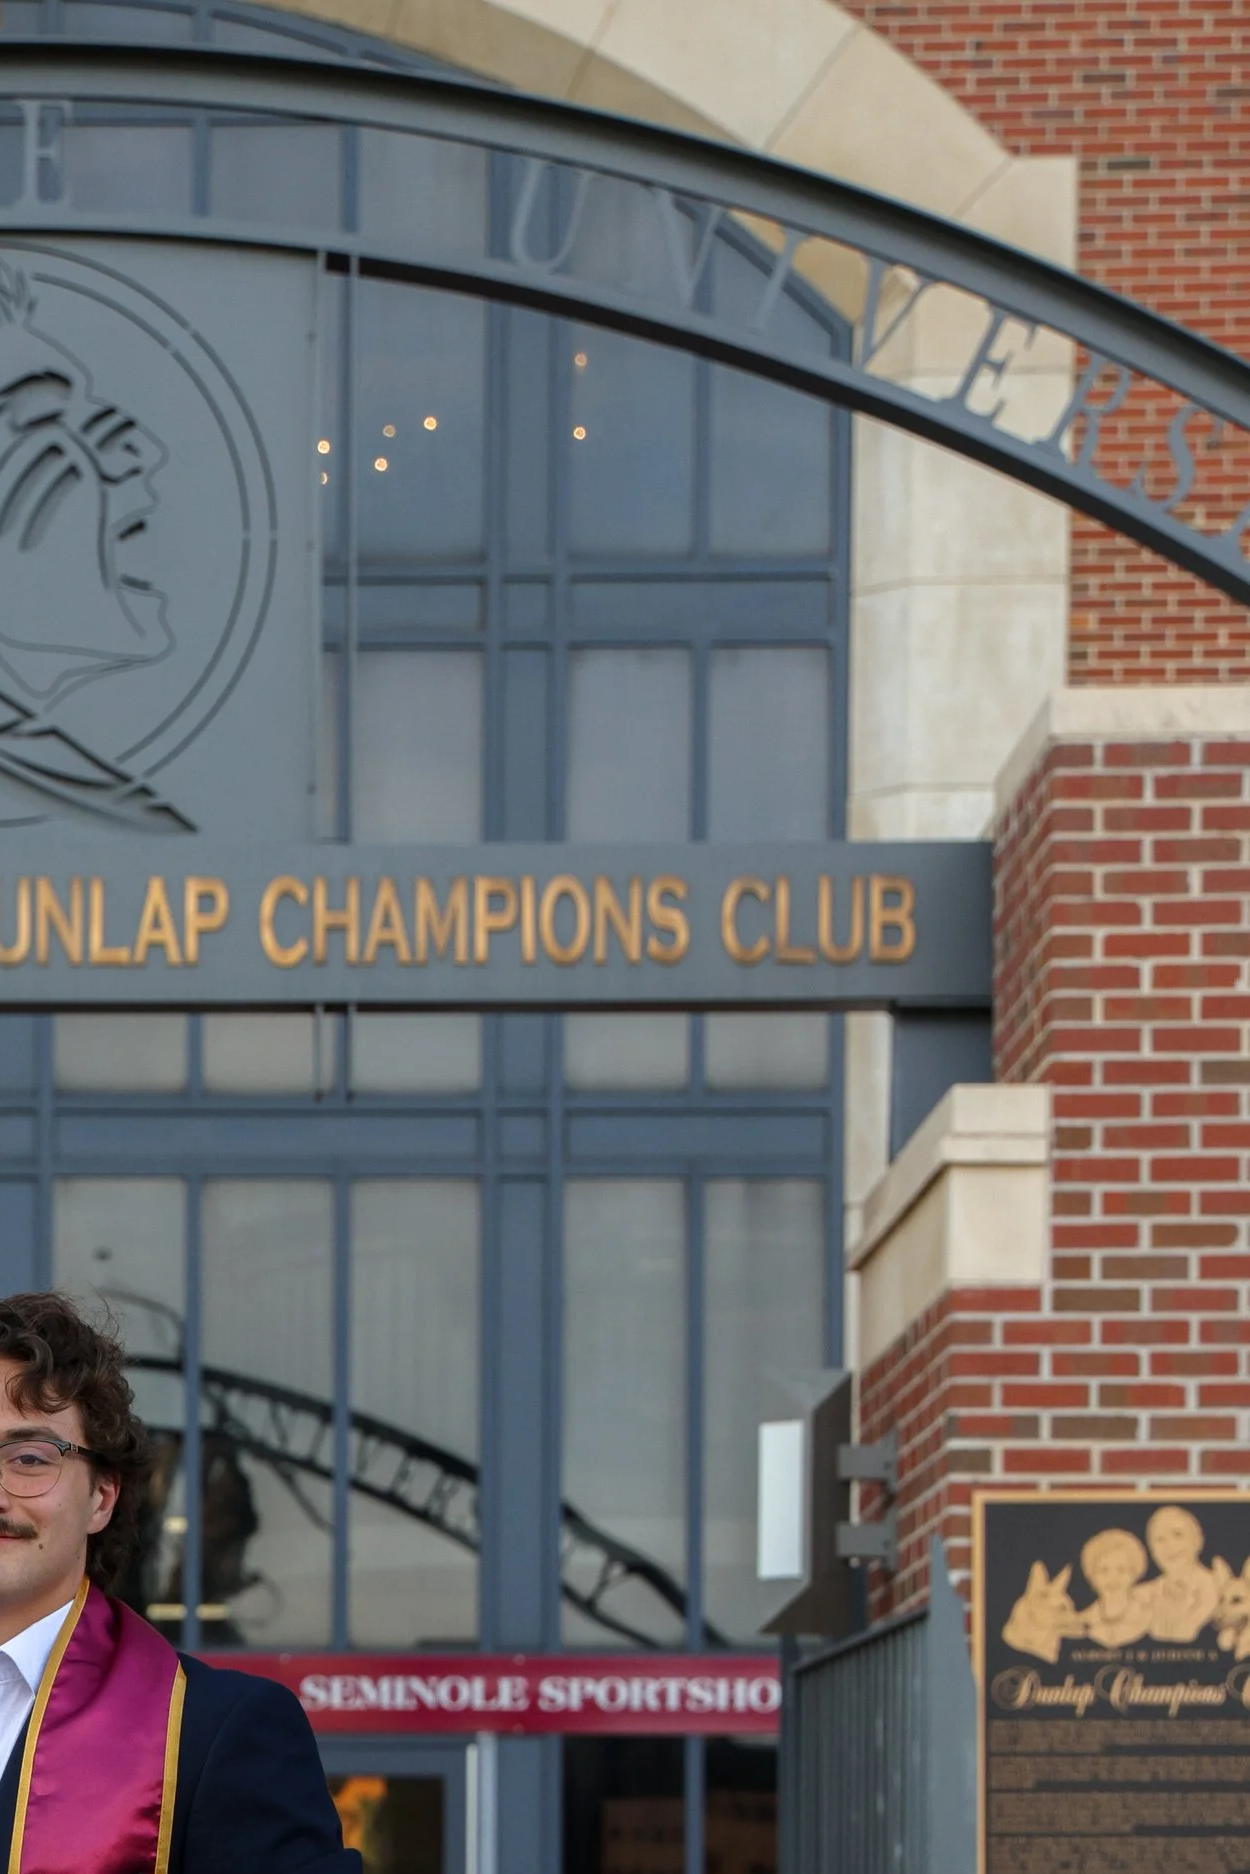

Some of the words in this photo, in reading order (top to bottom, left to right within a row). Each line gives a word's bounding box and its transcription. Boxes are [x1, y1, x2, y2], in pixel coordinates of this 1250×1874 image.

[257, 874, 691, 968] CHAMPIONS
[719, 874, 918, 966] CLUB
[299, 1674, 530, 1713] SEMINOLE
[537, 1675, 783, 1715] SPORTSHO
